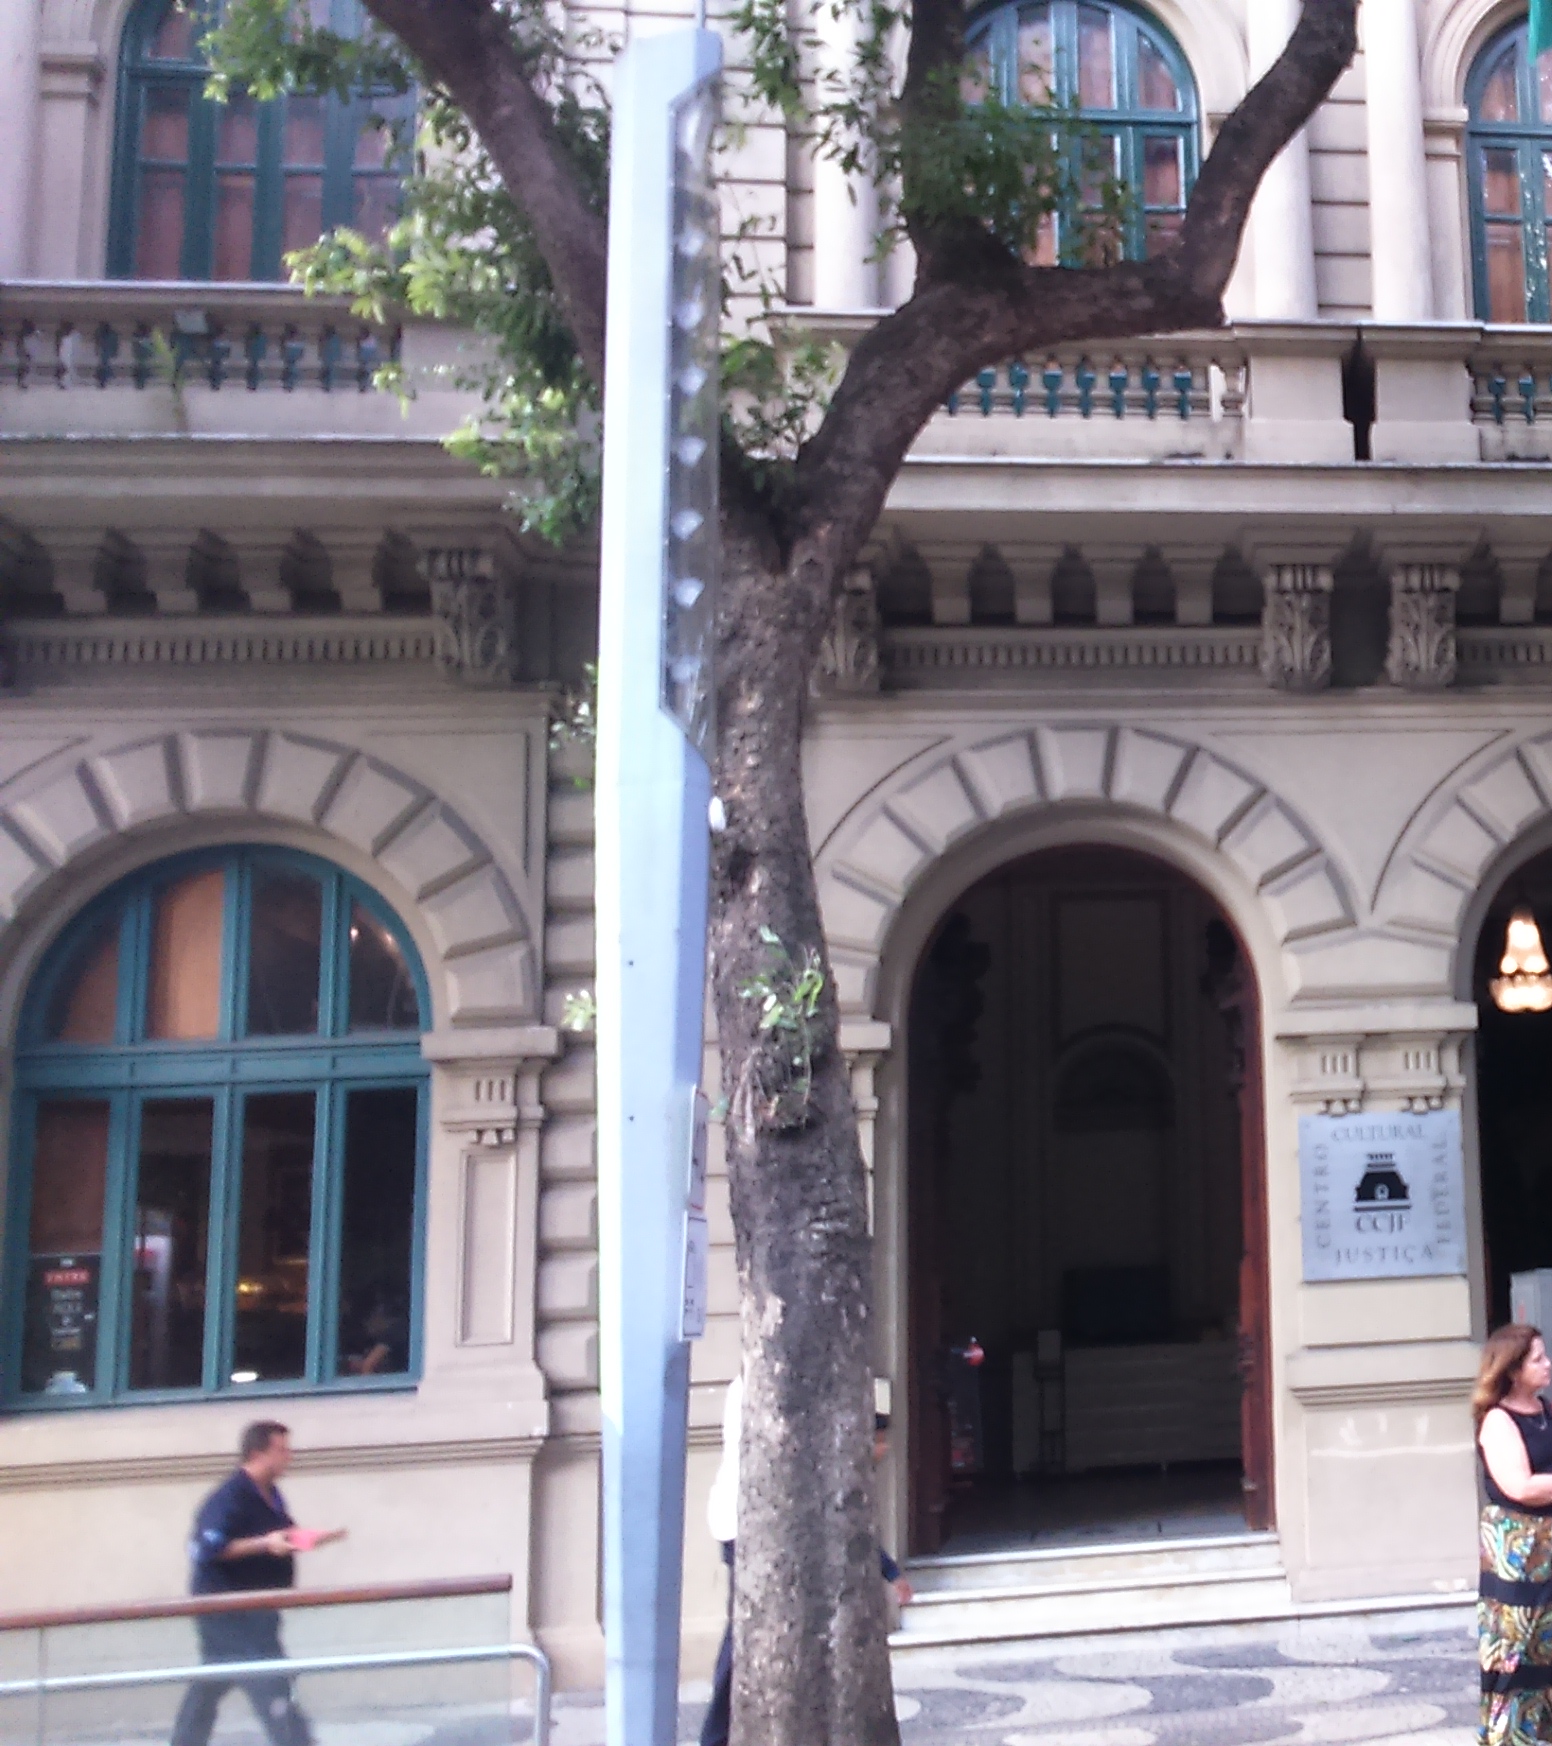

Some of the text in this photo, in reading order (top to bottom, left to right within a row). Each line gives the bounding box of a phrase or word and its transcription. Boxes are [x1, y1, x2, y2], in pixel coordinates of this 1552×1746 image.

[1331, 1125, 1425, 1141] CULTURAL
[1313, 1143, 1331, 1249] CENTRO
[1431, 1131, 1452, 1244] FEDERAL
[1355, 1213, 1411, 1234] CCJF
[1335, 1245, 1434, 1263] JUSTIÇA
